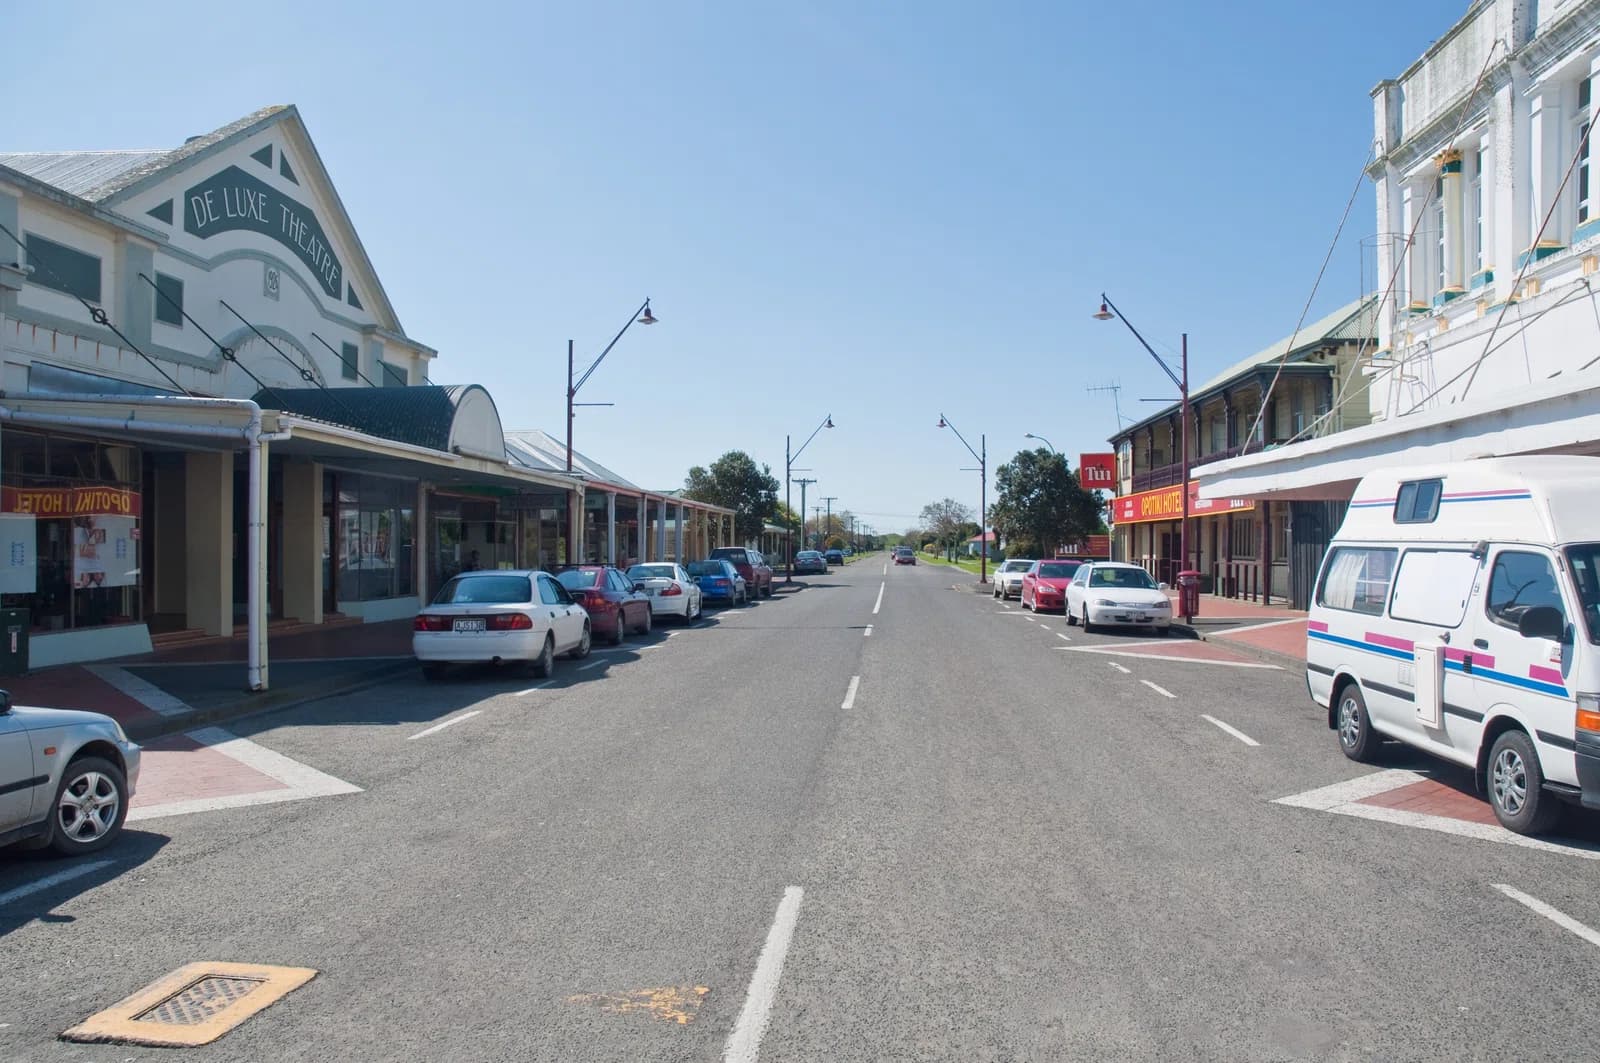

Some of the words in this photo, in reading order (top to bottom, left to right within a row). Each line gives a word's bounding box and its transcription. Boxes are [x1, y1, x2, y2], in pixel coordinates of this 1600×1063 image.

[191, 189, 220, 229] DE
[223, 187, 269, 223] LUXE
[279, 203, 339, 292] THEATRE
[1085, 466, 1111, 480] Tui
[1141, 494, 1163, 516] OPOTIKI
[1164, 489, 1183, 513] HOTEL
